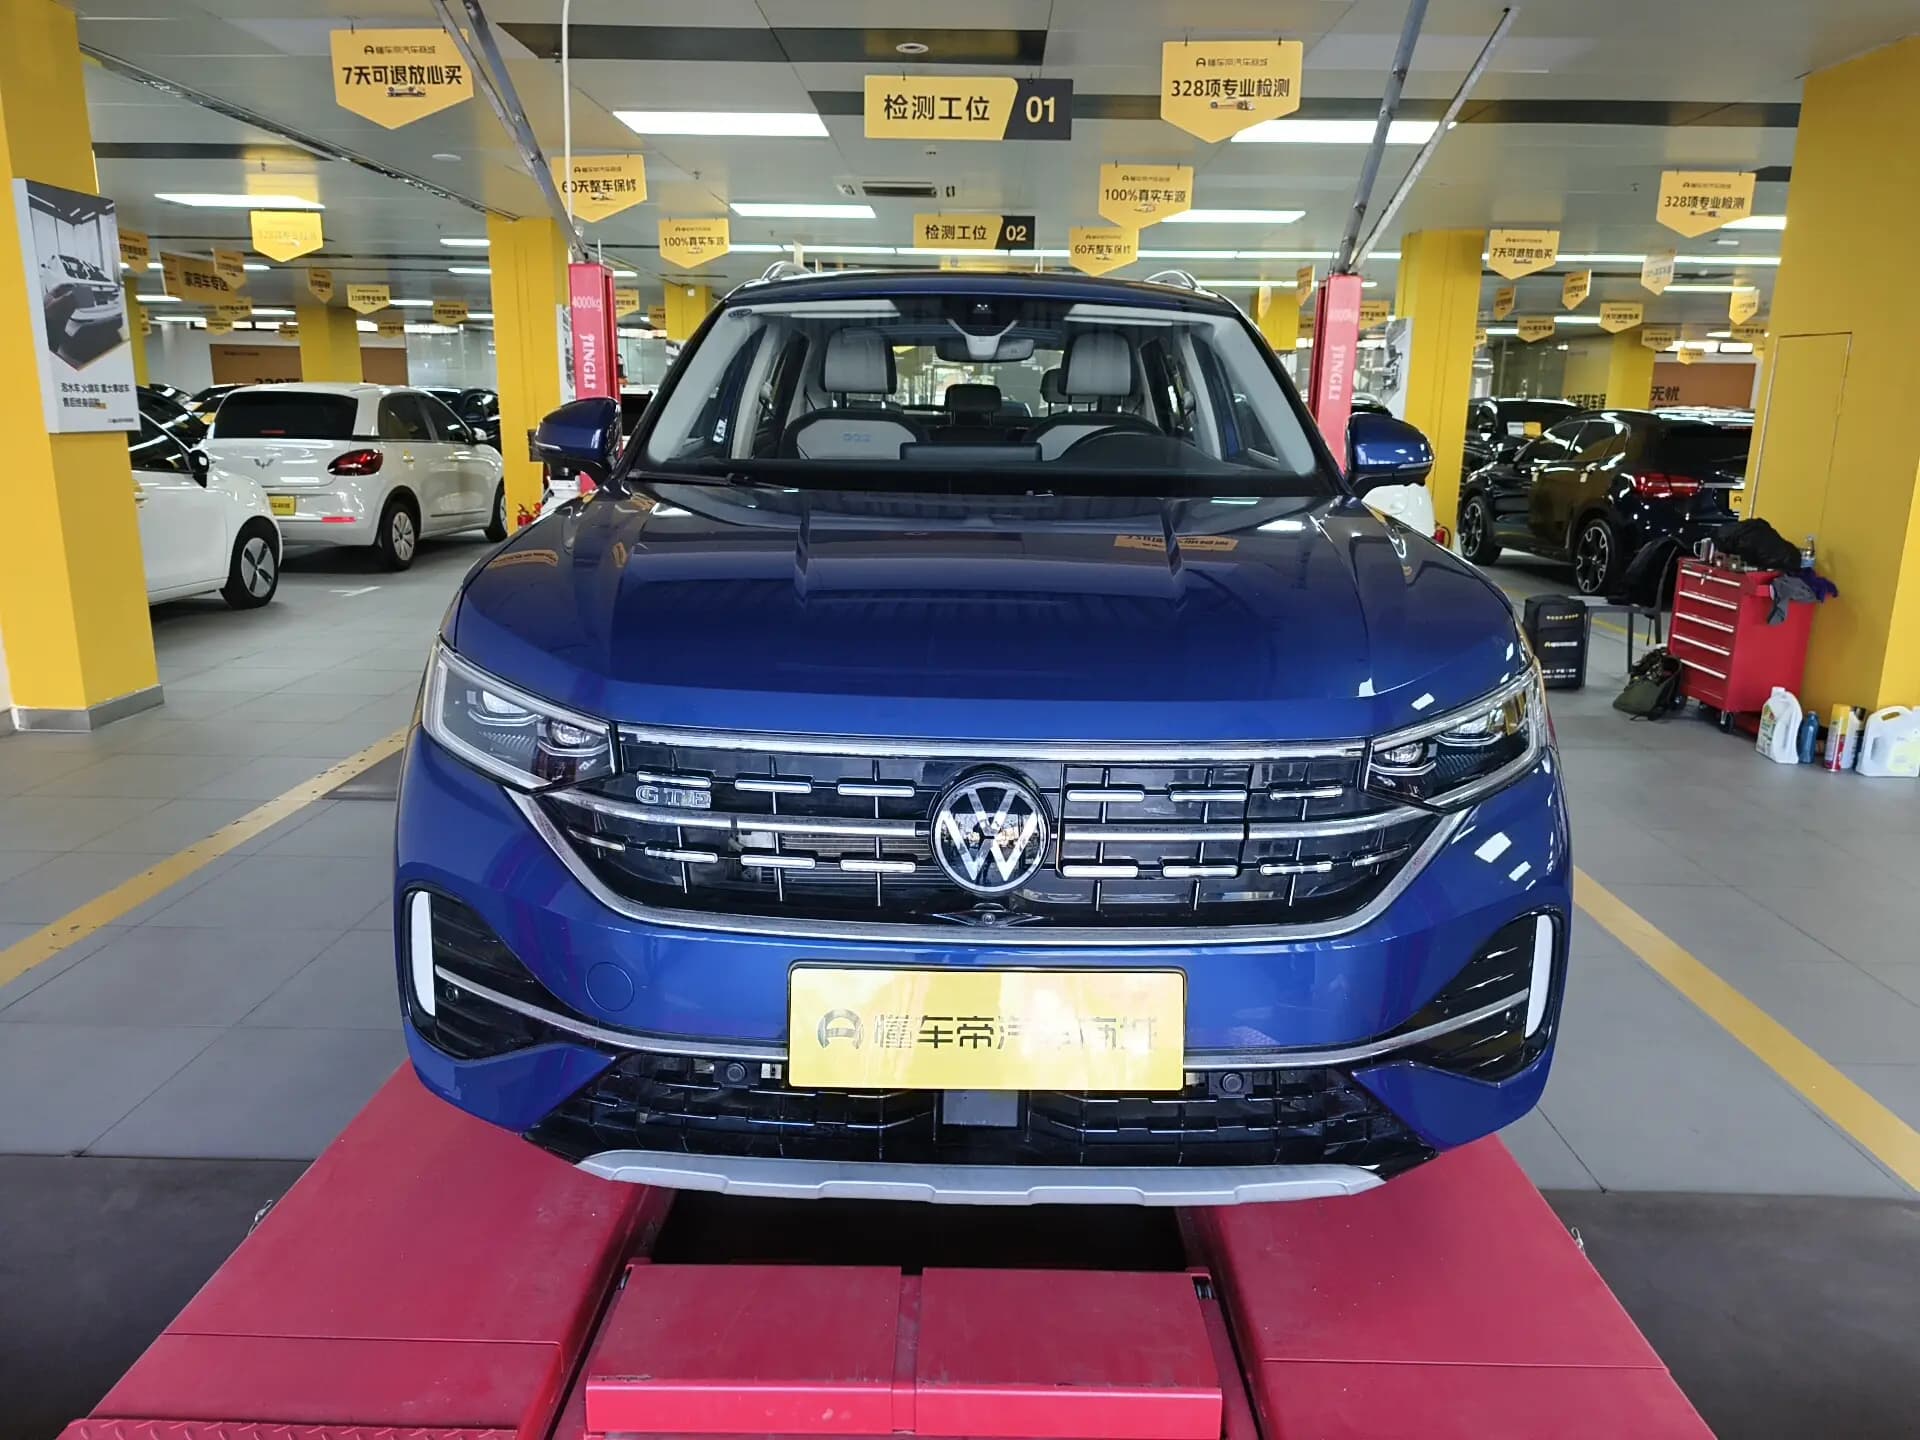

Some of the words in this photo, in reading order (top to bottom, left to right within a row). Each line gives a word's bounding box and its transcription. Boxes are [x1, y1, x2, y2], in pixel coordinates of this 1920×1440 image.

[342, 65, 463, 85] 7天可退放心买
[1171, 78, 1290, 98] 328项专业检测
[884, 94, 990, 122] 检测工位
[1026, 96, 1056, 123] 01
[562, 178, 637, 194] 60天整车保修
[1104, 188, 1186, 202] 100%真实车源
[1664, 196, 1745, 209] 328项专业检测
[664, 236, 724, 247] 100%真实车源
[925, 224, 987, 241] 检测工位
[1006, 225, 1027, 241] 02
[579, 333, 597, 390] JINGLI
[1328, 344, 1347, 400] JINGLI
